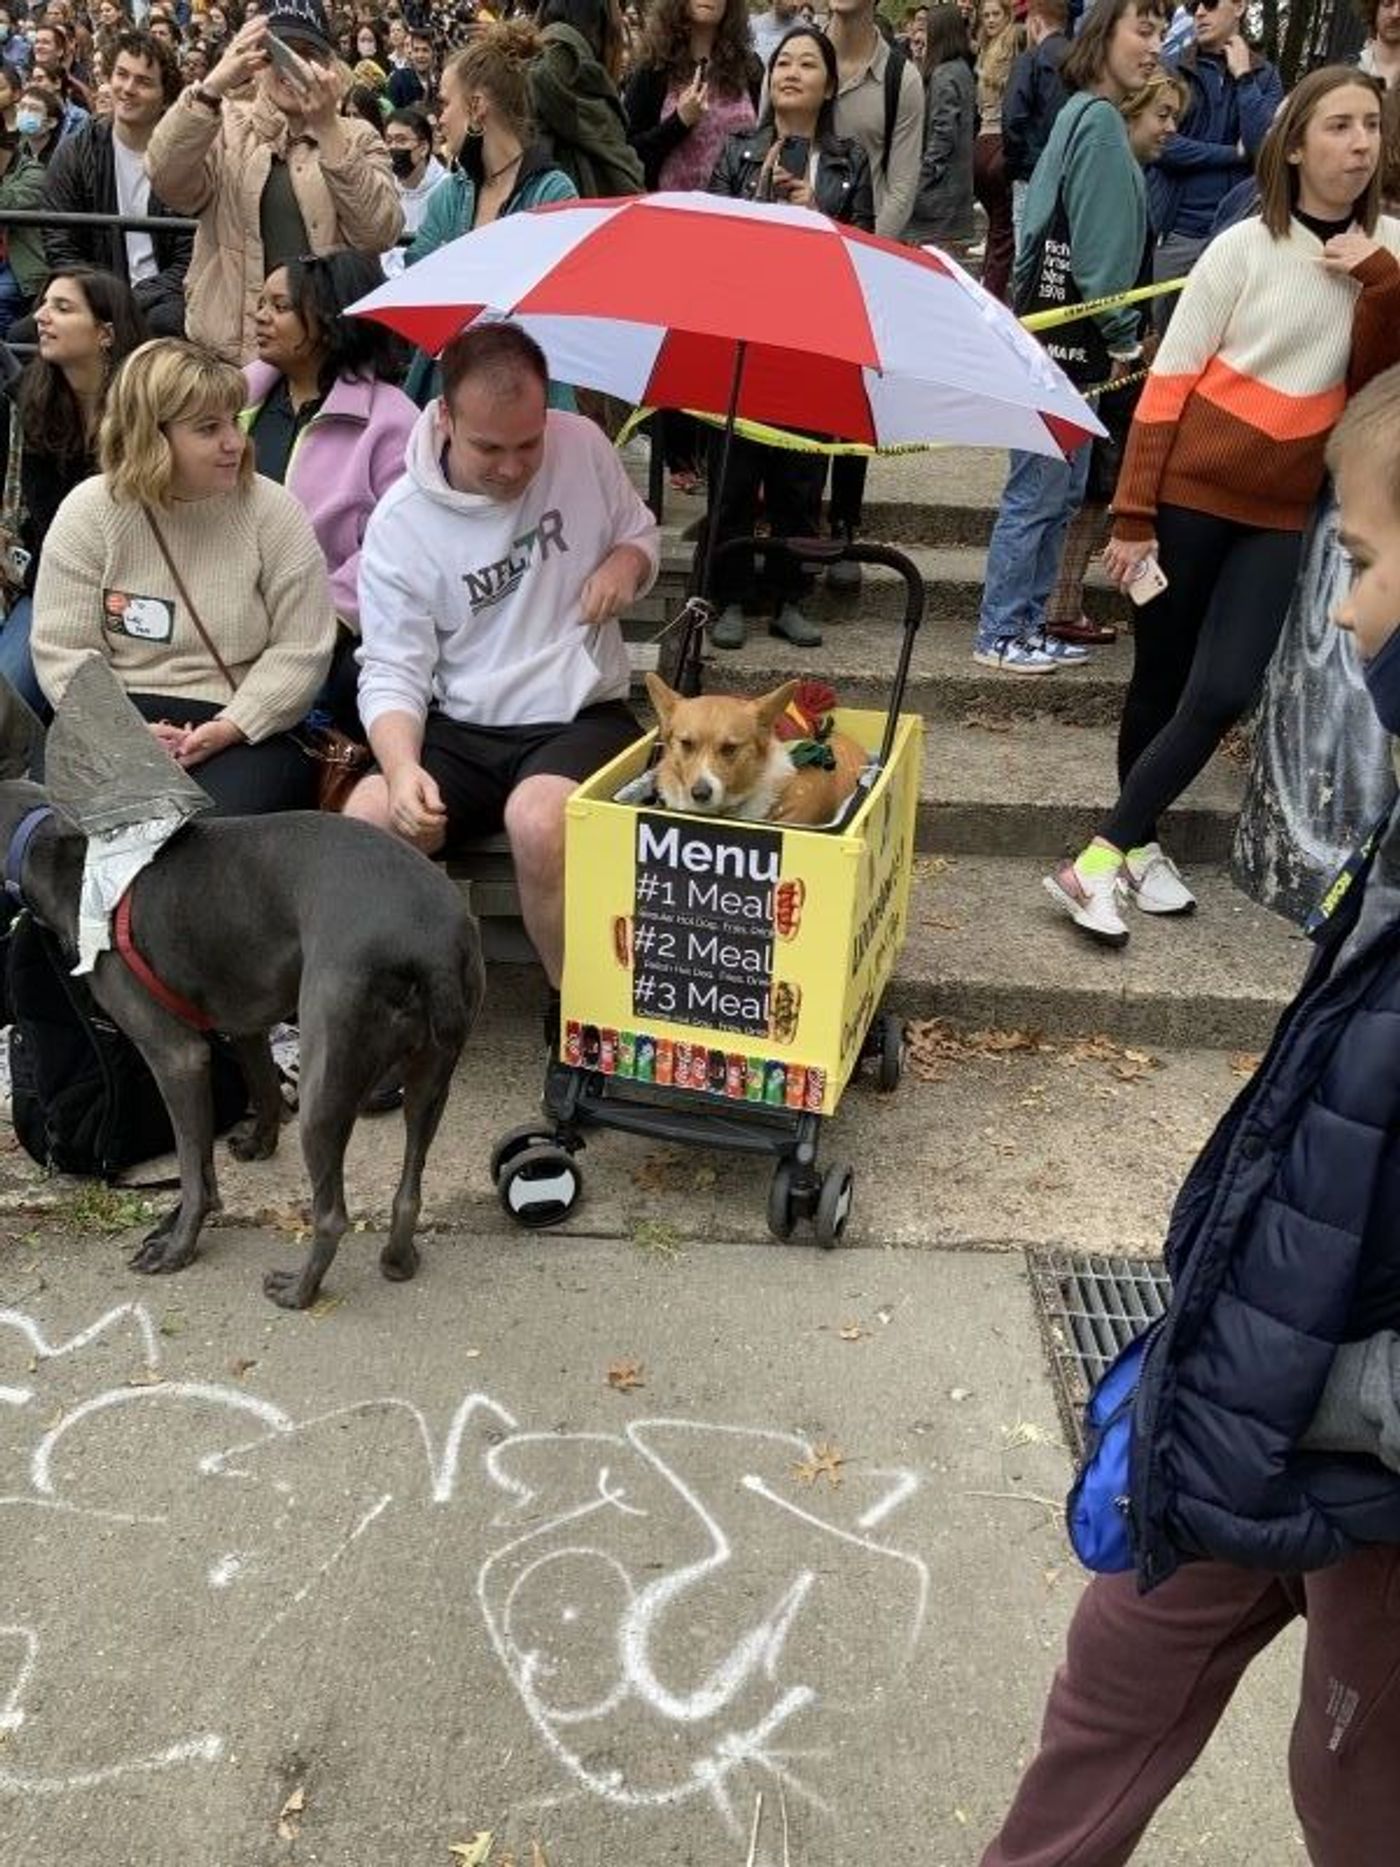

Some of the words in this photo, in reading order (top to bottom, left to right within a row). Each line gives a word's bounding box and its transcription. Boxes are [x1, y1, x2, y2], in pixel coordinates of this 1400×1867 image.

[638, 822, 779, 883] Menu
[637, 872, 675, 905] #1
[688, 879, 774, 920] Meal
[634, 924, 675, 958] #2
[688, 933, 775, 974] Meal
[634, 975, 675, 1011] #3
[688, 982, 770, 1021] Meal
